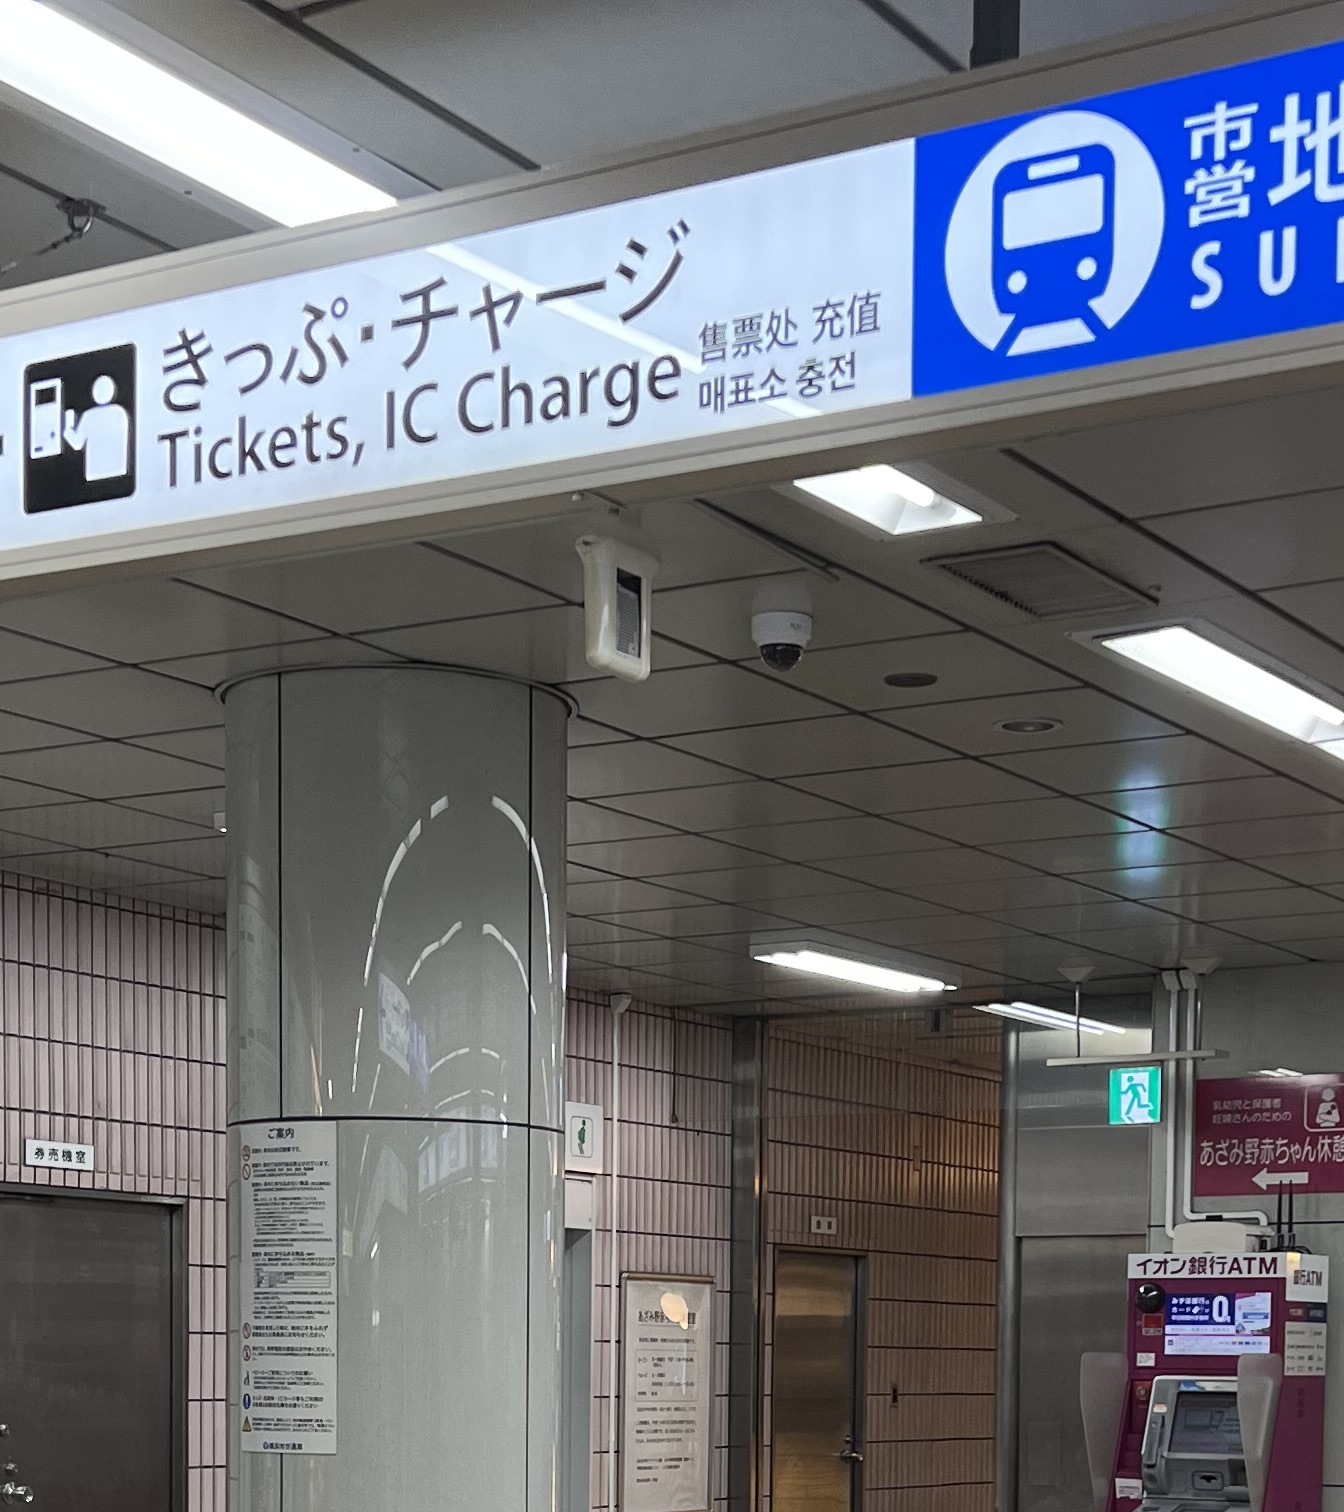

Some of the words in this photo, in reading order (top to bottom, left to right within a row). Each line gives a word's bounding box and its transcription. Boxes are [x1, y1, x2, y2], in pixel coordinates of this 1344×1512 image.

[1183, 101, 1257, 227] 市営
[159, 219, 691, 417] きっぷ・チャージ
[698, 307, 798, 364] 售票处
[811, 291, 881, 343] 充值
[157, 408, 364, 489] Tickets,
[385, 385, 438, 451] IC
[457, 345, 681, 437] Charge
[698, 366, 789, 415] 매표소
[794, 351, 858, 397] 충전
[35, 1147, 86, 1164] 券売機室
[268, 1128, 294, 1139] ご案内
[1136, 1255, 1278, 1276] イオン銀行ATM
